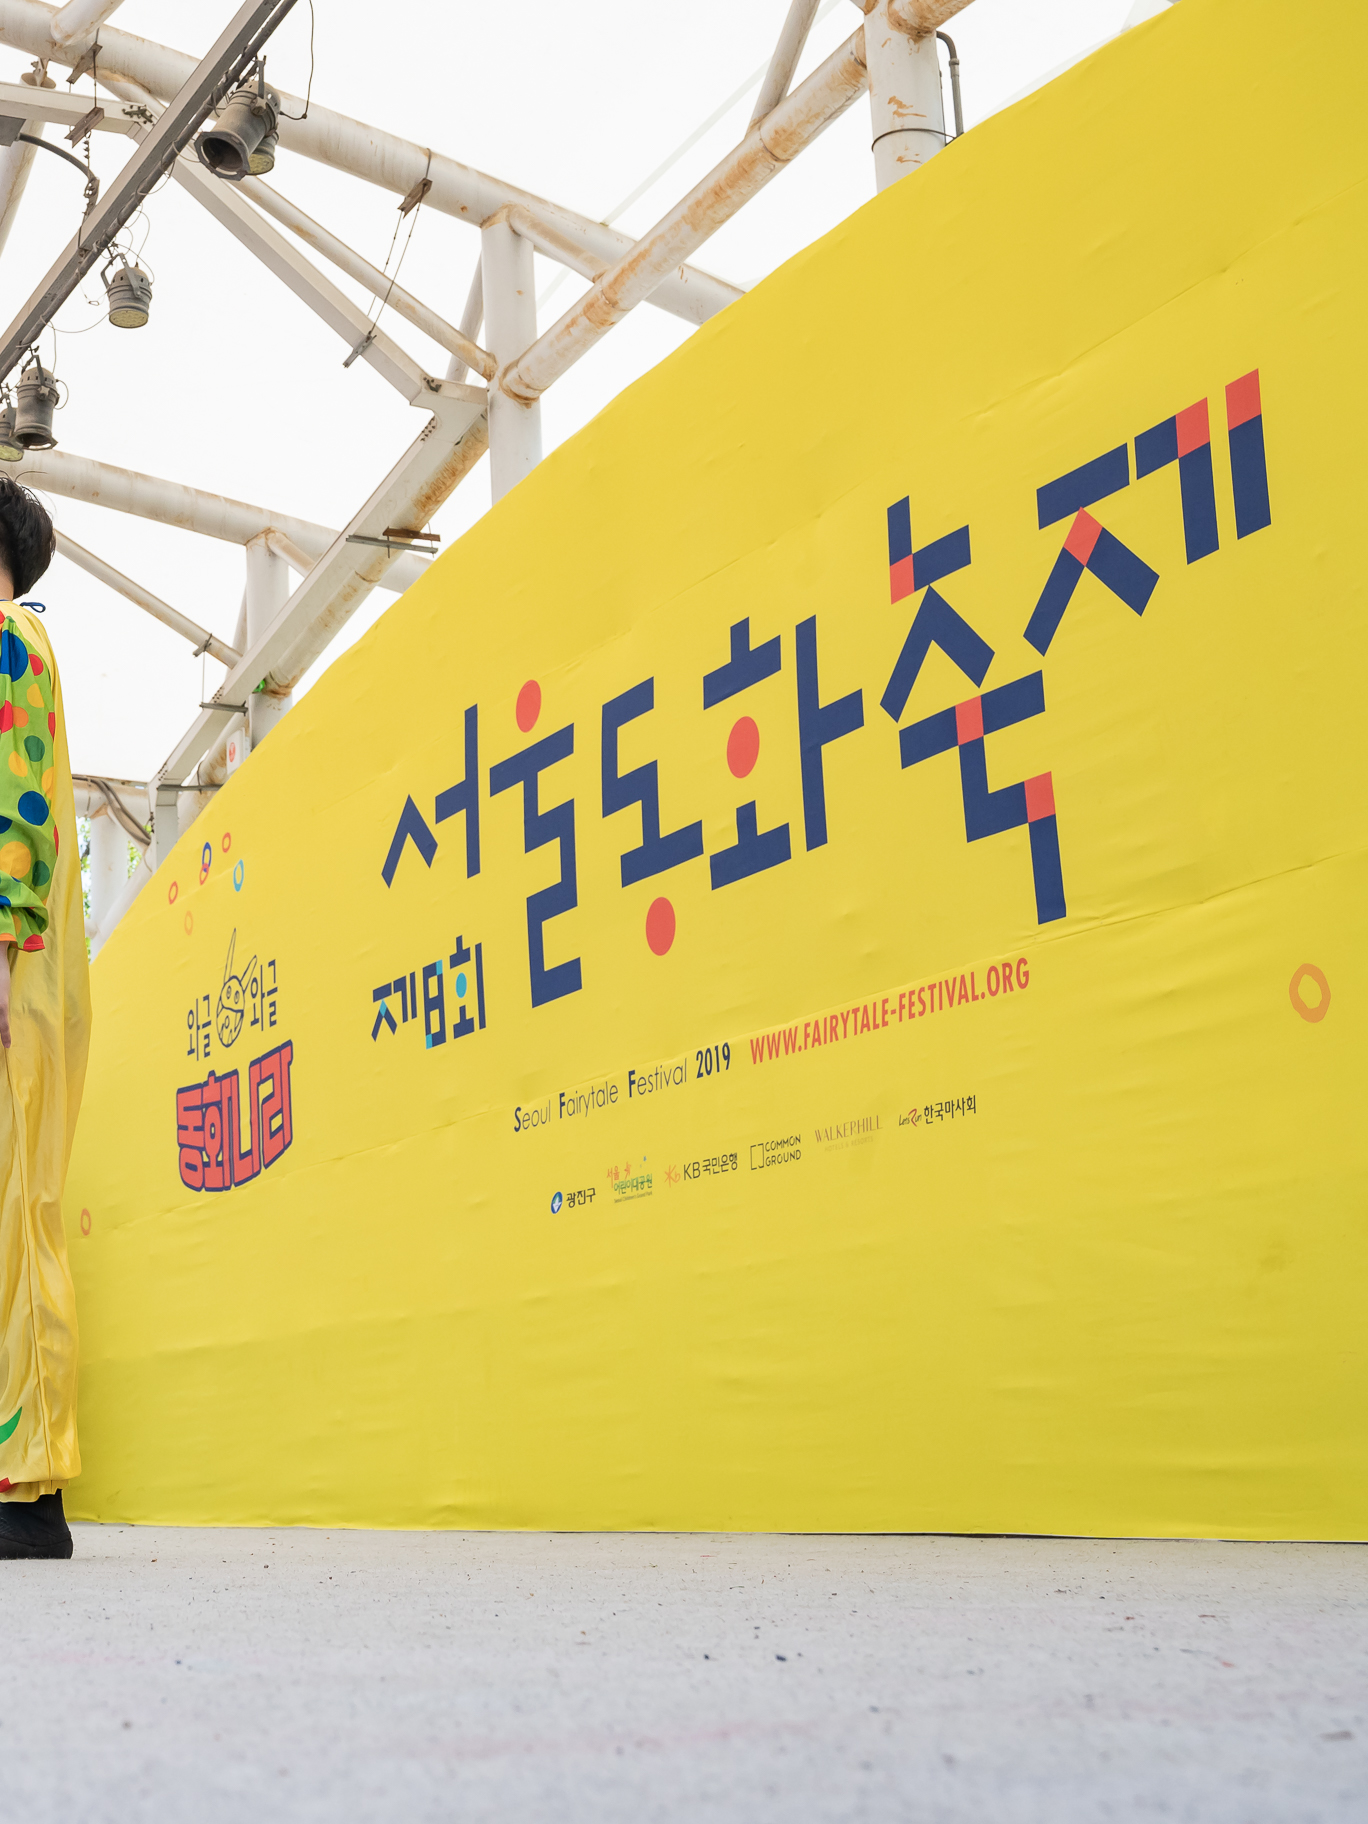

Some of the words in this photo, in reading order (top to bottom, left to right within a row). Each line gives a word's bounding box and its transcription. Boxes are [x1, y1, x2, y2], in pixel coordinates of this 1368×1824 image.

[381, 368, 1272, 1009] 서울동화축제
[371, 935, 486, 1050] 제8회
[187, 994, 212, 1061] 와글
[250, 959, 279, 1032] 와글
[514, 1099, 551, 1132] Seoul
[559, 1081, 619, 1119] Fairytale
[628, 1057, 687, 1098] Festival
[696, 1042, 731, 1078] 2019
[750, 957, 1030, 1065] WWW.FAIRYTALE-FESTIVAL.ORG
[176, 1039, 293, 1192] 동화나라
[923, 1094, 977, 1125] 한국마사회
[765, 1134, 802, 1152] COMMON
[814, 1114, 884, 1144] WALKERHILL
[765, 1149, 802, 1167] GROUND
[607, 1165, 620, 1189] 서울
[614, 1173, 653, 1195] 어린이대공원
[566, 1187, 596, 1208] 광진구
